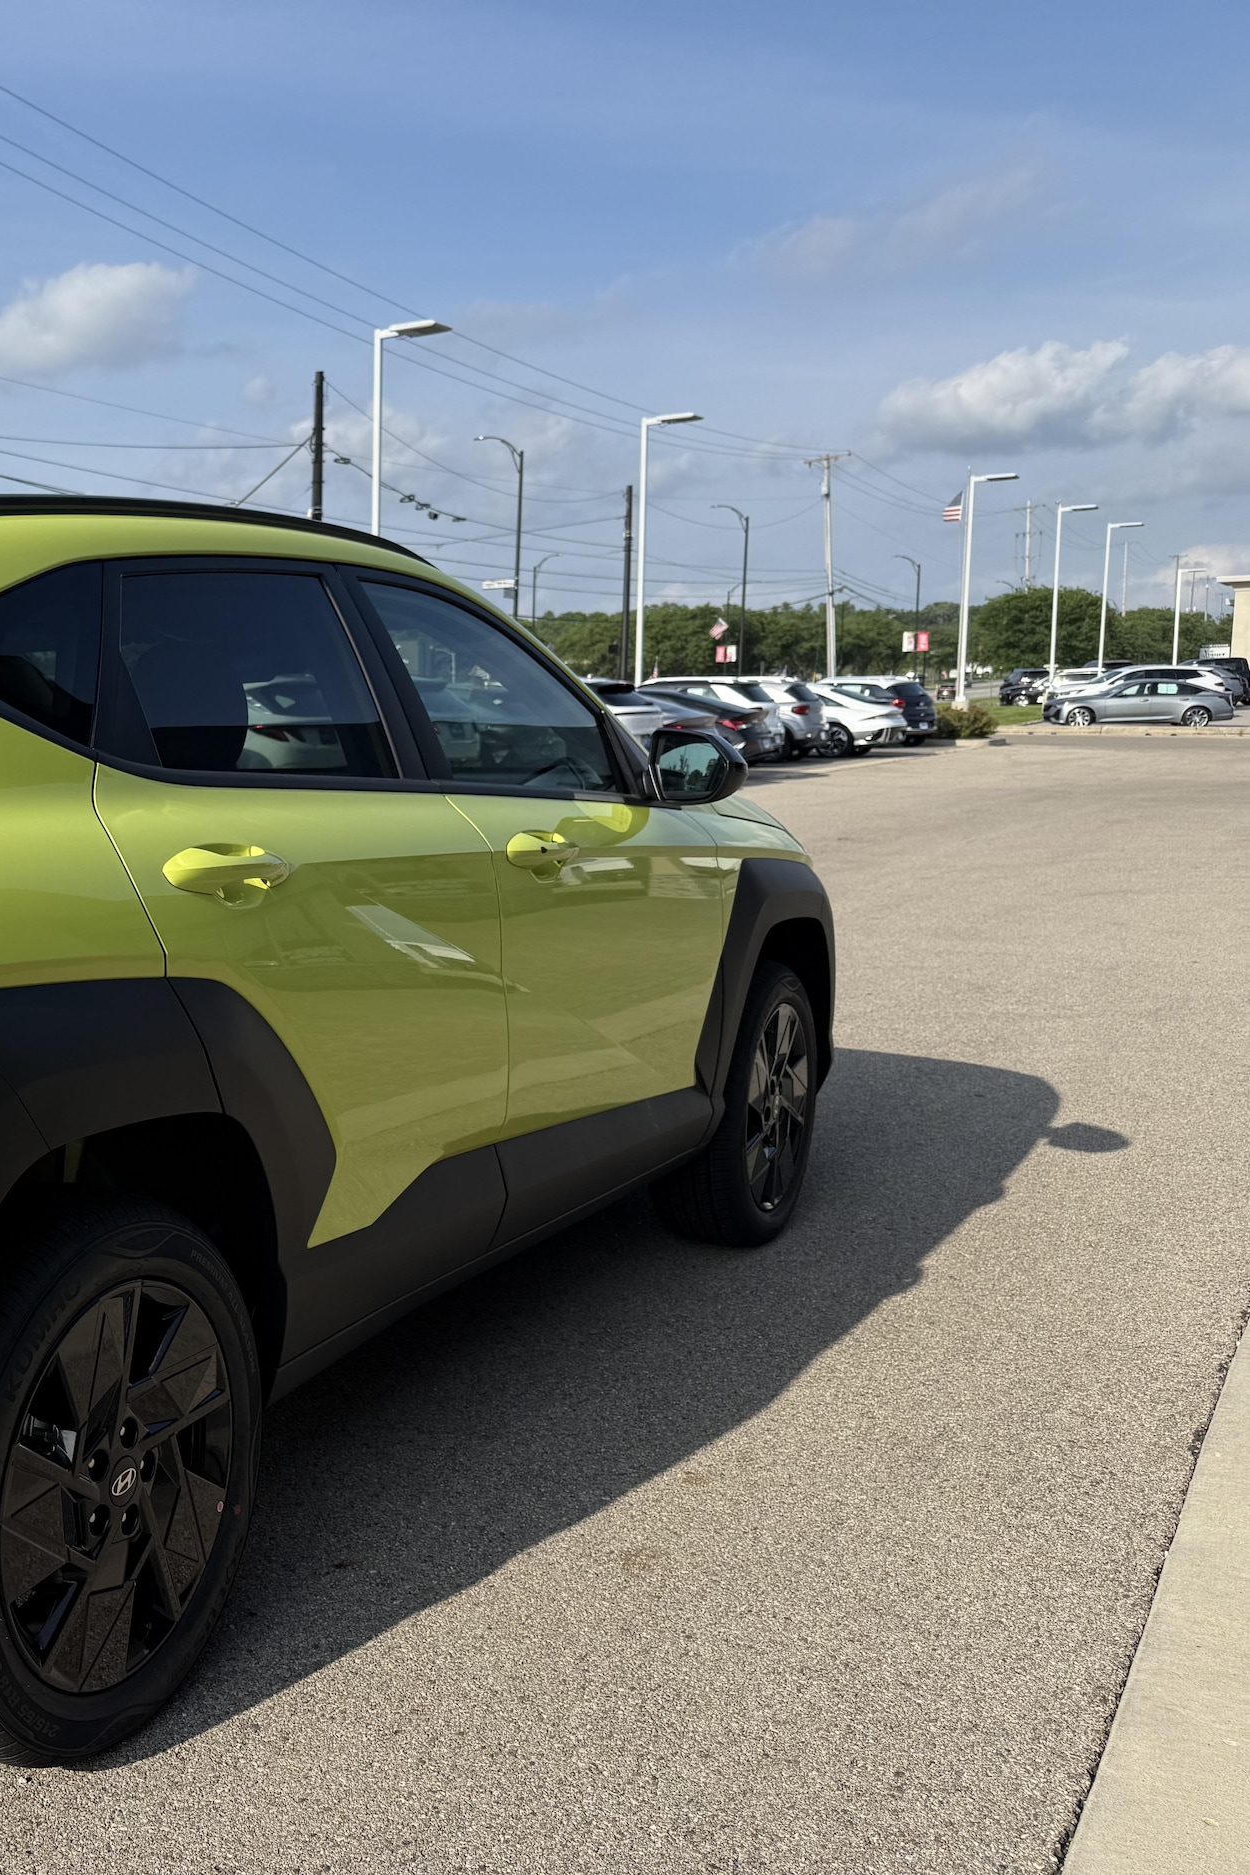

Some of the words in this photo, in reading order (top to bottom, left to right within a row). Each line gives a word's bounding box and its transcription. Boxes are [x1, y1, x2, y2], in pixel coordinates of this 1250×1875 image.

[190, 1248, 227, 1291] PREMIUM
[4, 1277, 81, 1404] KUMHO
[17, 1703, 60, 1738] 215/55
